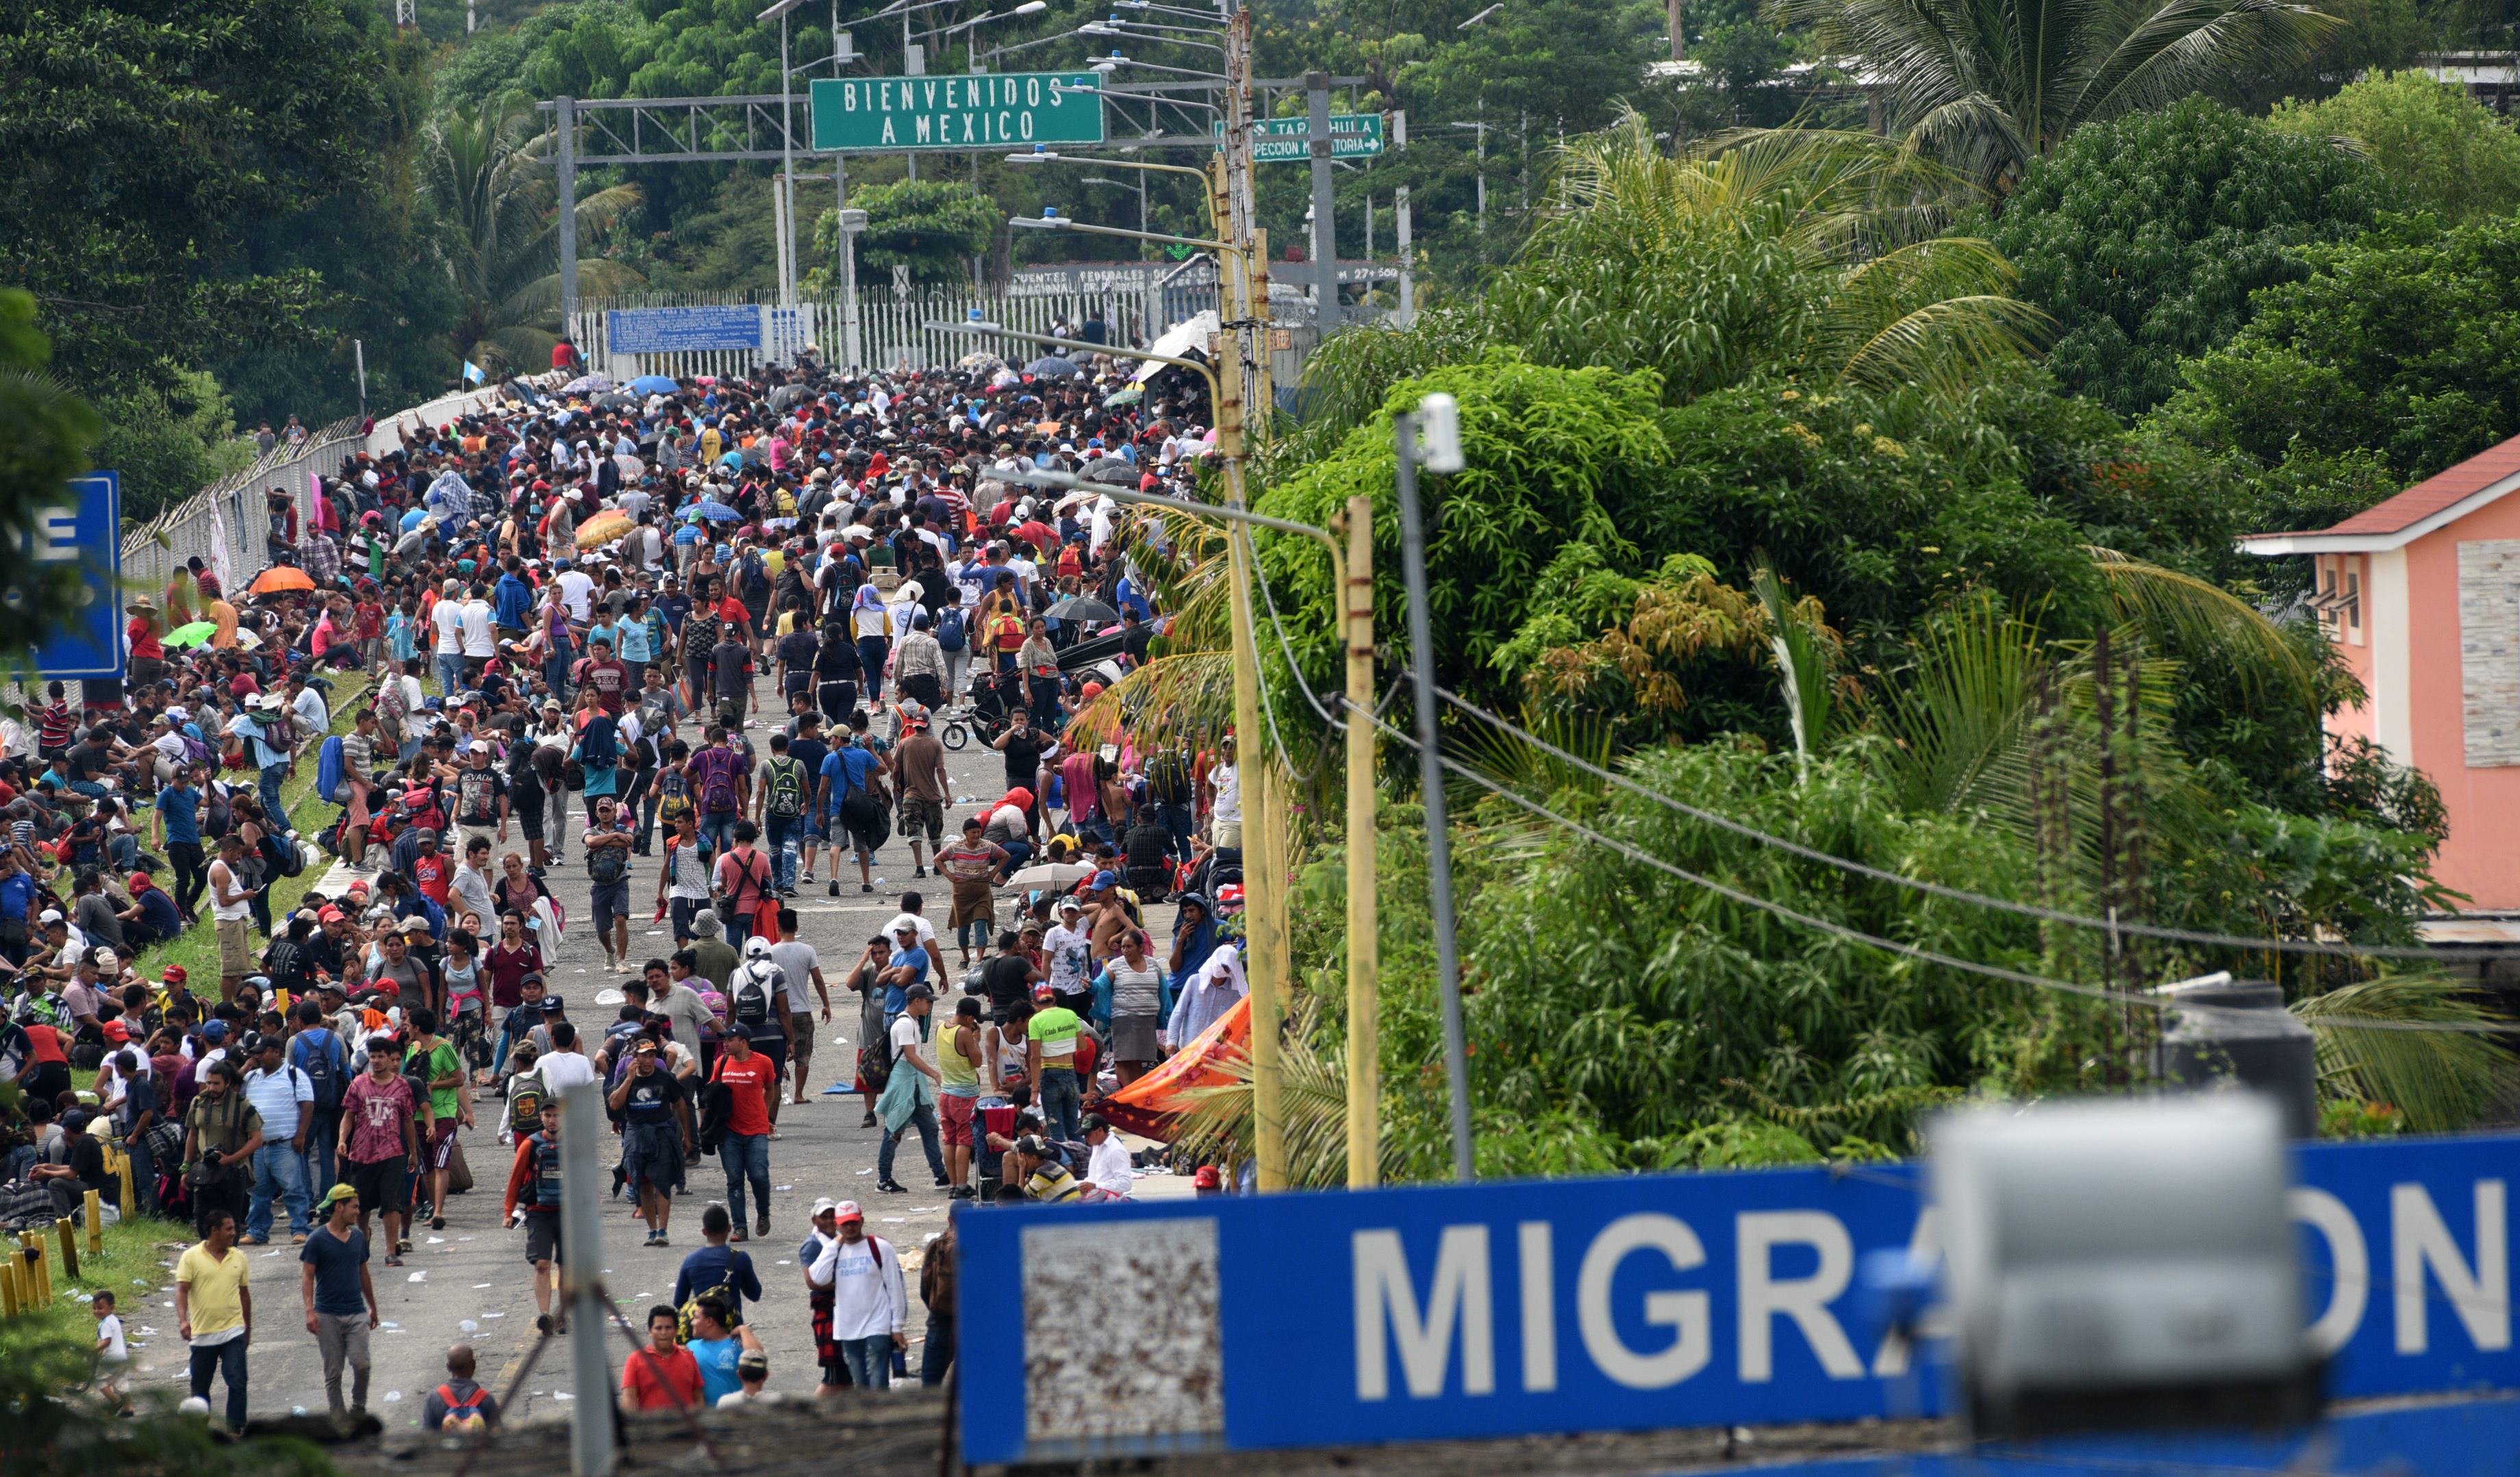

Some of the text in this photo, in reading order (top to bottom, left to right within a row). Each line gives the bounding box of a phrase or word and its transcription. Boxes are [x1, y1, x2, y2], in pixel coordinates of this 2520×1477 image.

[844, 77, 1063, 112] BIENVENIDOS
[882, 111, 1033, 144] A MEXICO
[1276, 120, 1372, 135] TAPHULA
[1252, 140, 1299, 156] PECCION
[460, 772, 493, 782] NEVADA
[1352, 1179, 2511, 1402] MIGRON
